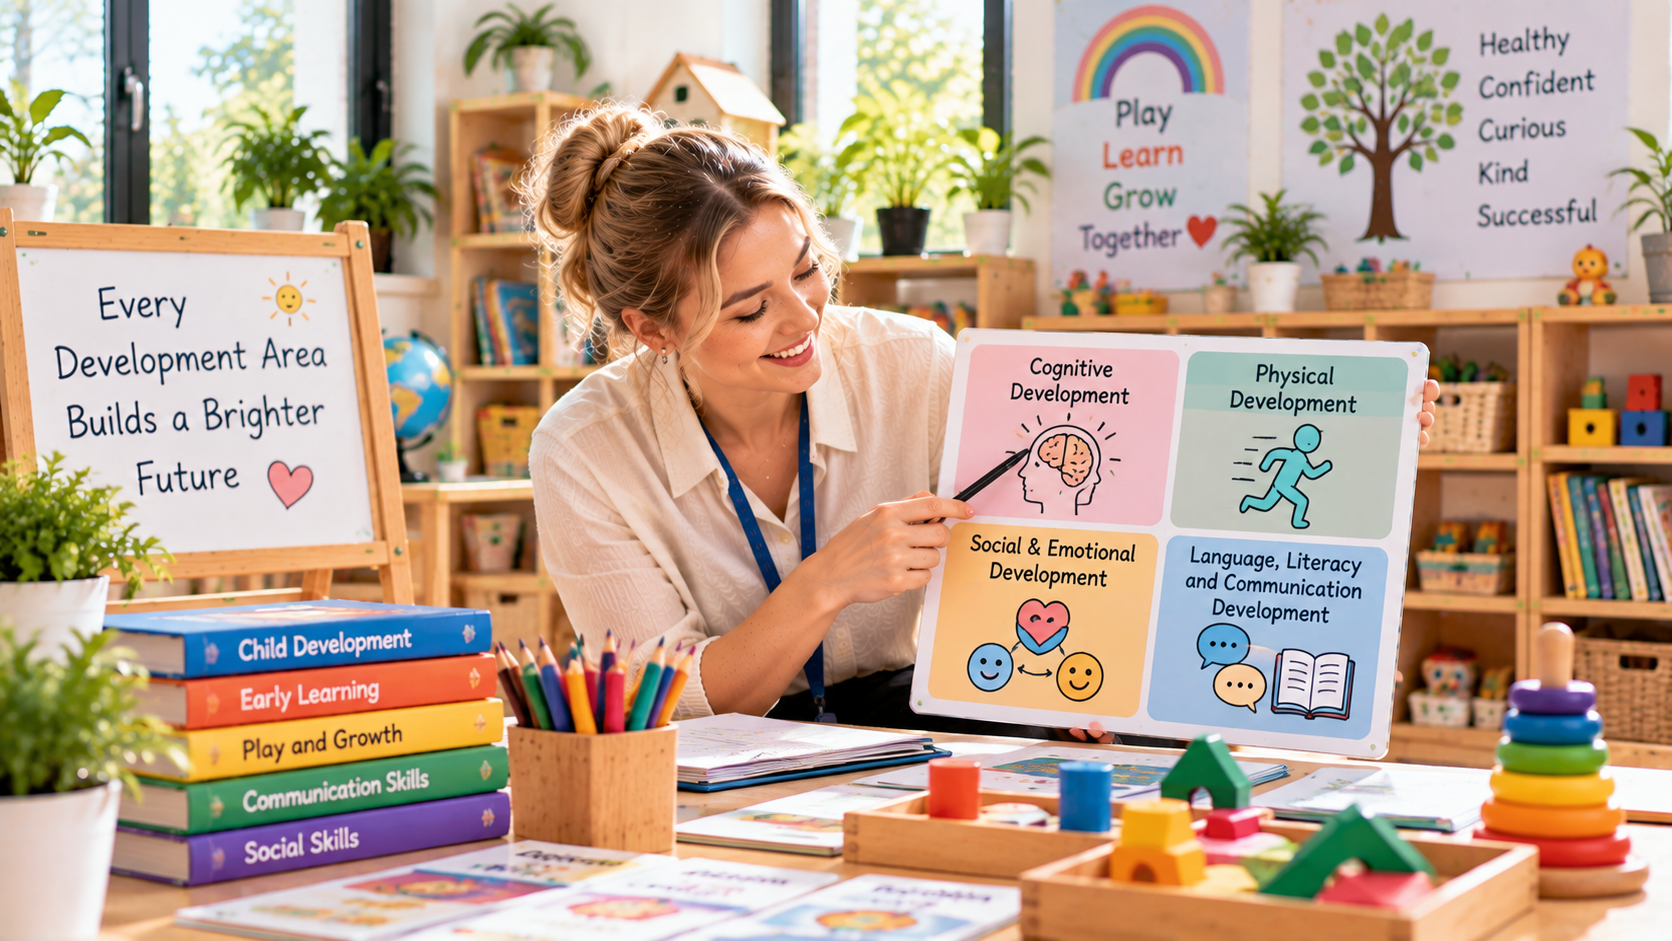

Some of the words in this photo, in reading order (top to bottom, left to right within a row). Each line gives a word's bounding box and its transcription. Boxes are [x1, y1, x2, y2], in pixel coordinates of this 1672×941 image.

[1480, 26, 1570, 57] Healthy
[1478, 69, 1596, 100] Confident
[1116, 98, 1173, 134] Play
[1478, 116, 1567, 143] Curious
[1103, 142, 1183, 170] Learn
[1478, 159, 1529, 185] Kind
[1103, 181, 1177, 211] Grow
[1477, 197, 1598, 228] Successful
[1079, 221, 1183, 259] Together
[97, 285, 187, 329] Every
[54, 341, 247, 386] Development
[261, 337, 328, 370] Area
[1029, 357, 1113, 382] Cognitive
[1255, 363, 1334, 390] Physical
[1010, 382, 1130, 409] Development
[1229, 389, 1358, 417] Development
[66, 400, 157, 439] Builds
[172, 411, 190, 432] a
[202, 394, 325, 441] Brighter
[136, 459, 240, 496] Future
[970, 534, 1022, 555] Social
[1027, 537, 1041, 556] &
[1047, 538, 1136, 563] Emotional
[1190, 545, 1280, 573] Language,
[1286, 551, 1363, 579] Literacy
[989, 561, 1108, 590] Development
[1185, 571, 1219, 590] and
[1223, 573, 1362, 600] Communication
[1212, 597, 1330, 625] Development
[238, 635, 288, 662] Child
[293, 628, 413, 658] Development
[240, 684, 292, 713] Early
[297, 679, 380, 706] Learning
[242, 737, 285, 764] Play
[291, 730, 327, 755] and
[333, 723, 403, 750] Growth
[242, 778, 382, 813] Communication
[385, 767, 430, 793] Skills
[244, 832, 305, 864] Social
[310, 826, 360, 854] Skills
